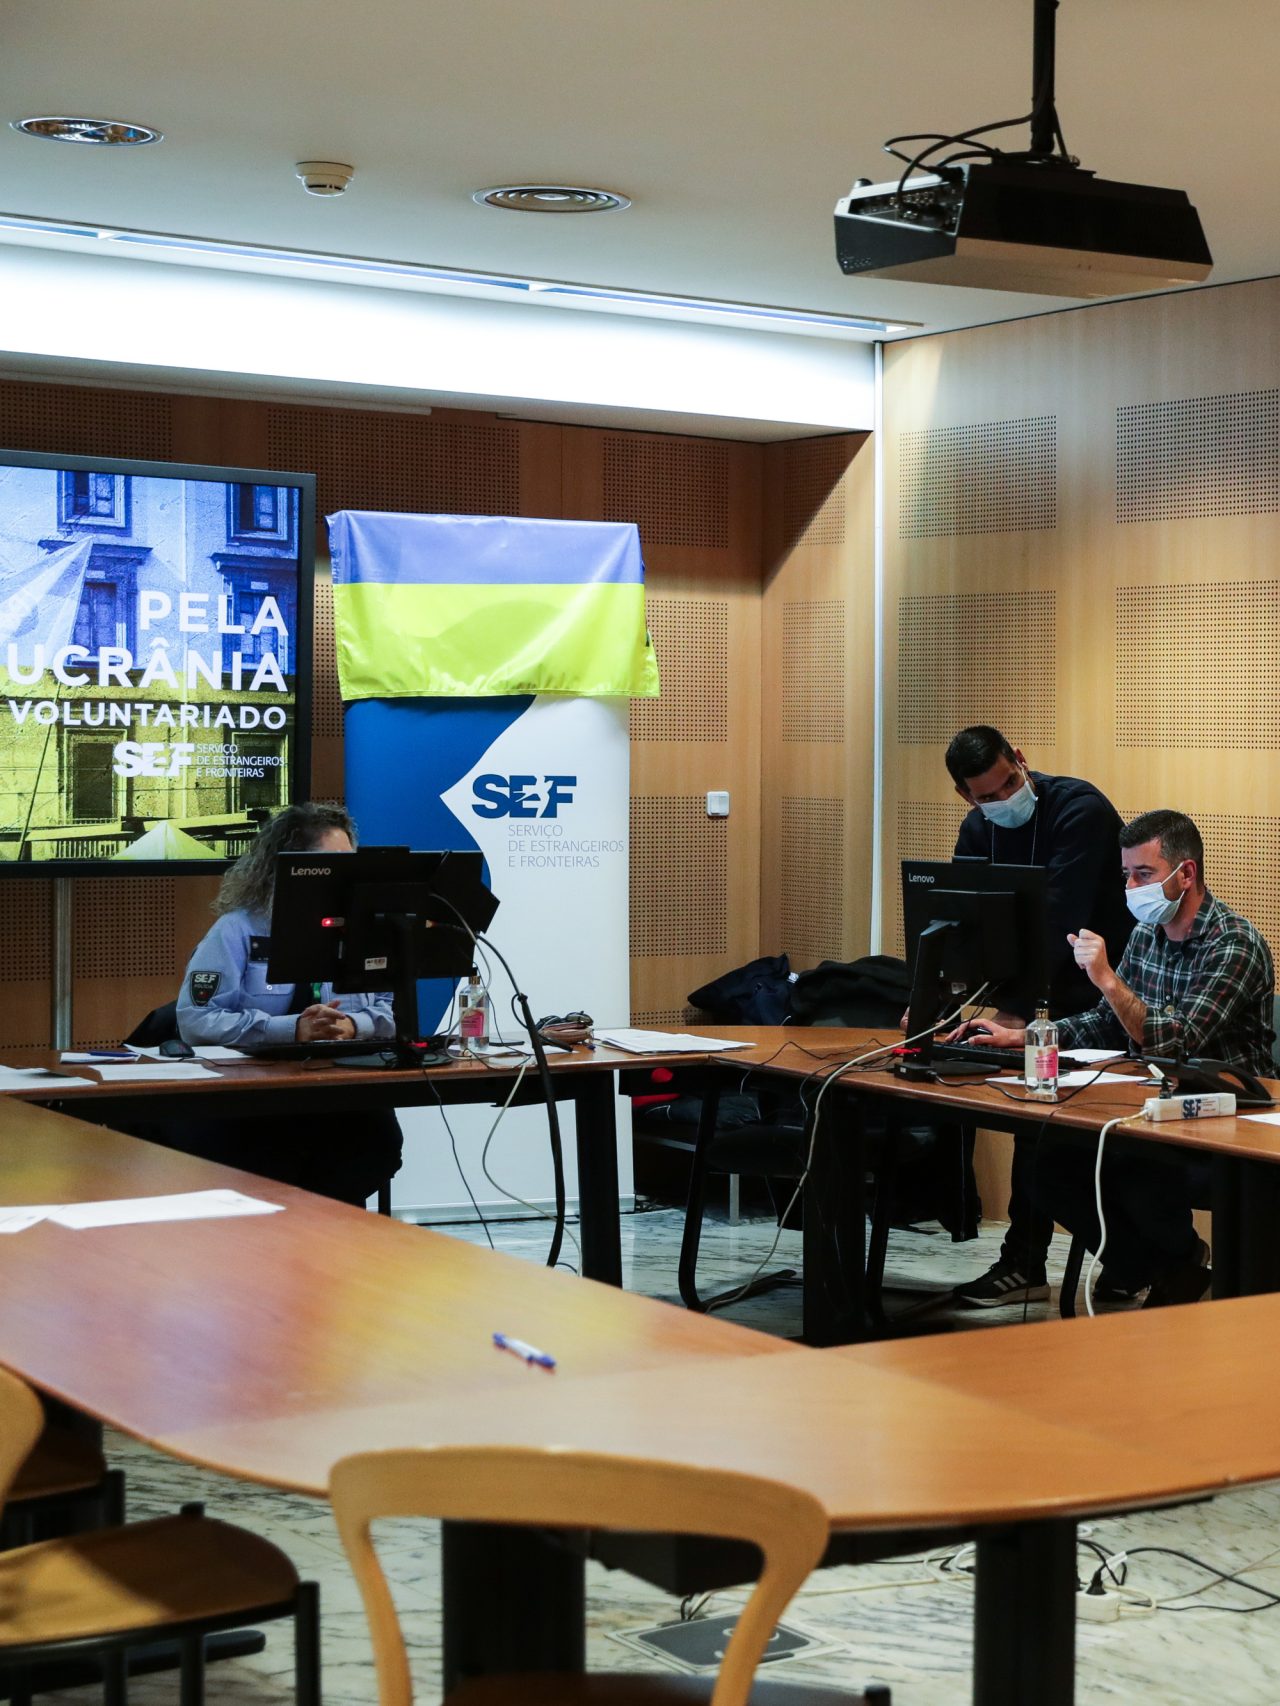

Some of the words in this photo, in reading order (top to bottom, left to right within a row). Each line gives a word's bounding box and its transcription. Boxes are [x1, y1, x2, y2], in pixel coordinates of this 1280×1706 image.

[139, 589, 289, 637] PELA
[7, 636, 288, 692] UCRÂNIA
[9, 699, 287, 730] VOLUNTARIADO
[196, 743, 238, 756] SERVIÇO
[112, 740, 195, 778] SEF
[196, 755, 210, 766] DE
[212, 755, 285, 767] ESTRANGEIROS
[196, 767, 202, 778] E
[205, 767, 265, 778] FRONTEIRAS
[471, 773, 577, 819] SEF
[507, 824, 563, 839] SERVIÇO
[507, 839, 527, 852] DE
[530, 839, 625, 853] ESTRANGEIROS
[507, 855, 516, 868] E
[519, 855, 600, 868] FRONTEIRAS
[290, 866, 332, 876] Lenovo
[908, 872, 935, 884] Lenovo
[194, 973, 217, 984] SEF
